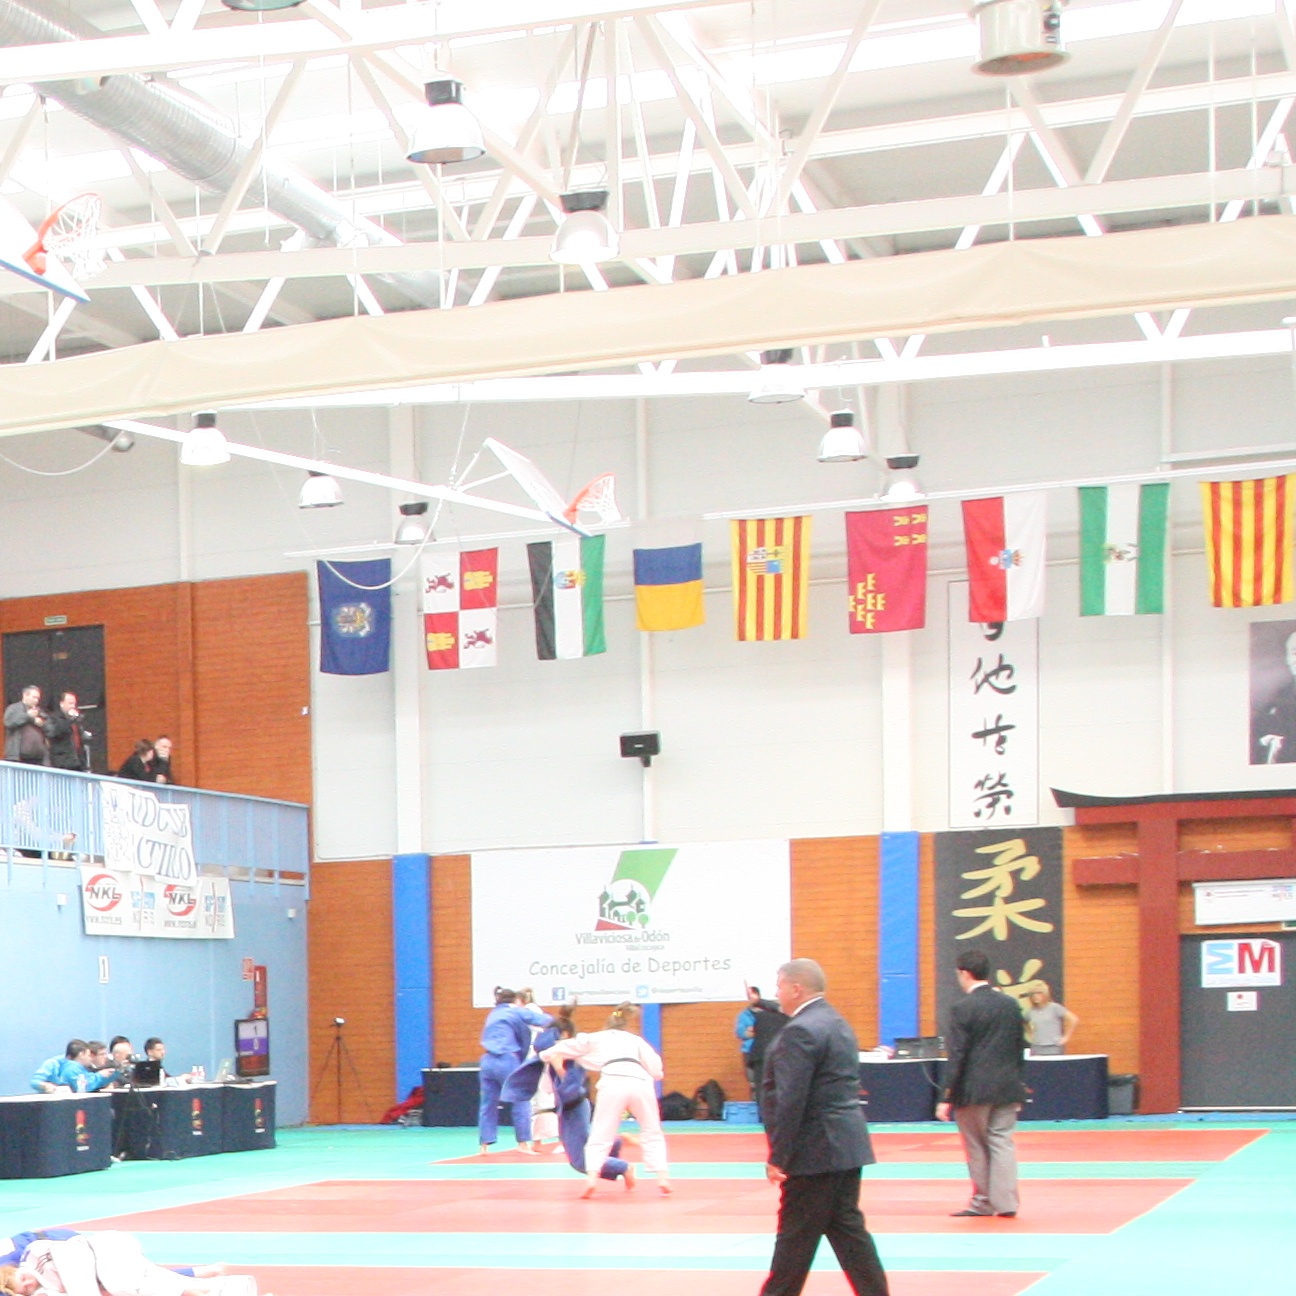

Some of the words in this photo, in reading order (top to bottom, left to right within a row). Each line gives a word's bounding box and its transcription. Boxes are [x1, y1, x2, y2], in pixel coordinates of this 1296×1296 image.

[89, 886, 121, 899] NKL
[169, 892, 196, 905] NKL
[575, 932, 632, 945] Villaviciosa
[641, 930, 670, 943] Odón
[528, 958, 615, 979] Concejalía
[621, 958, 641, 974] de
[648, 957, 731, 976] Deportes
